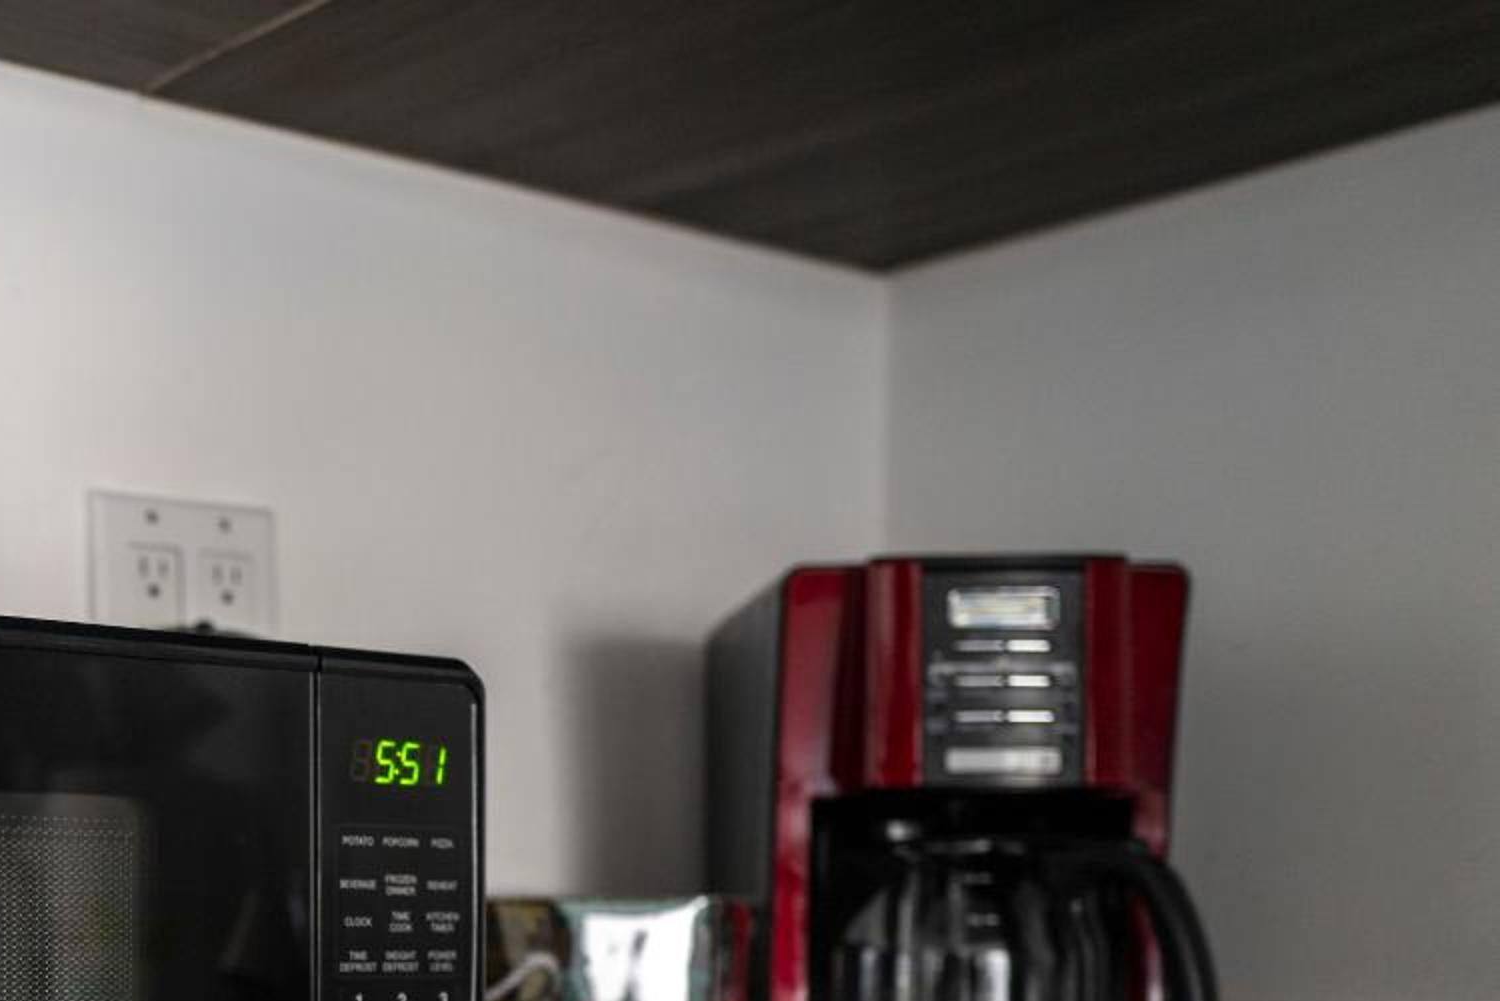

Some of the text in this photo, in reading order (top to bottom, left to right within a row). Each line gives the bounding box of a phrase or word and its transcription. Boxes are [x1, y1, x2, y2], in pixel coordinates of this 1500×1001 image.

[374, 740, 446, 785] 5:51
[341, 835, 375, 847] POTATO
[382, 836, 419, 848] POPCORN
[343, 916, 372, 928] CLOCK
[391, 911, 410, 921] TIME
[388, 922, 413, 932] COOK
[349, 950, 367, 961] TIME
[339, 961, 377, 973] DEFROST
[382, 961, 420, 973] DEFROST
